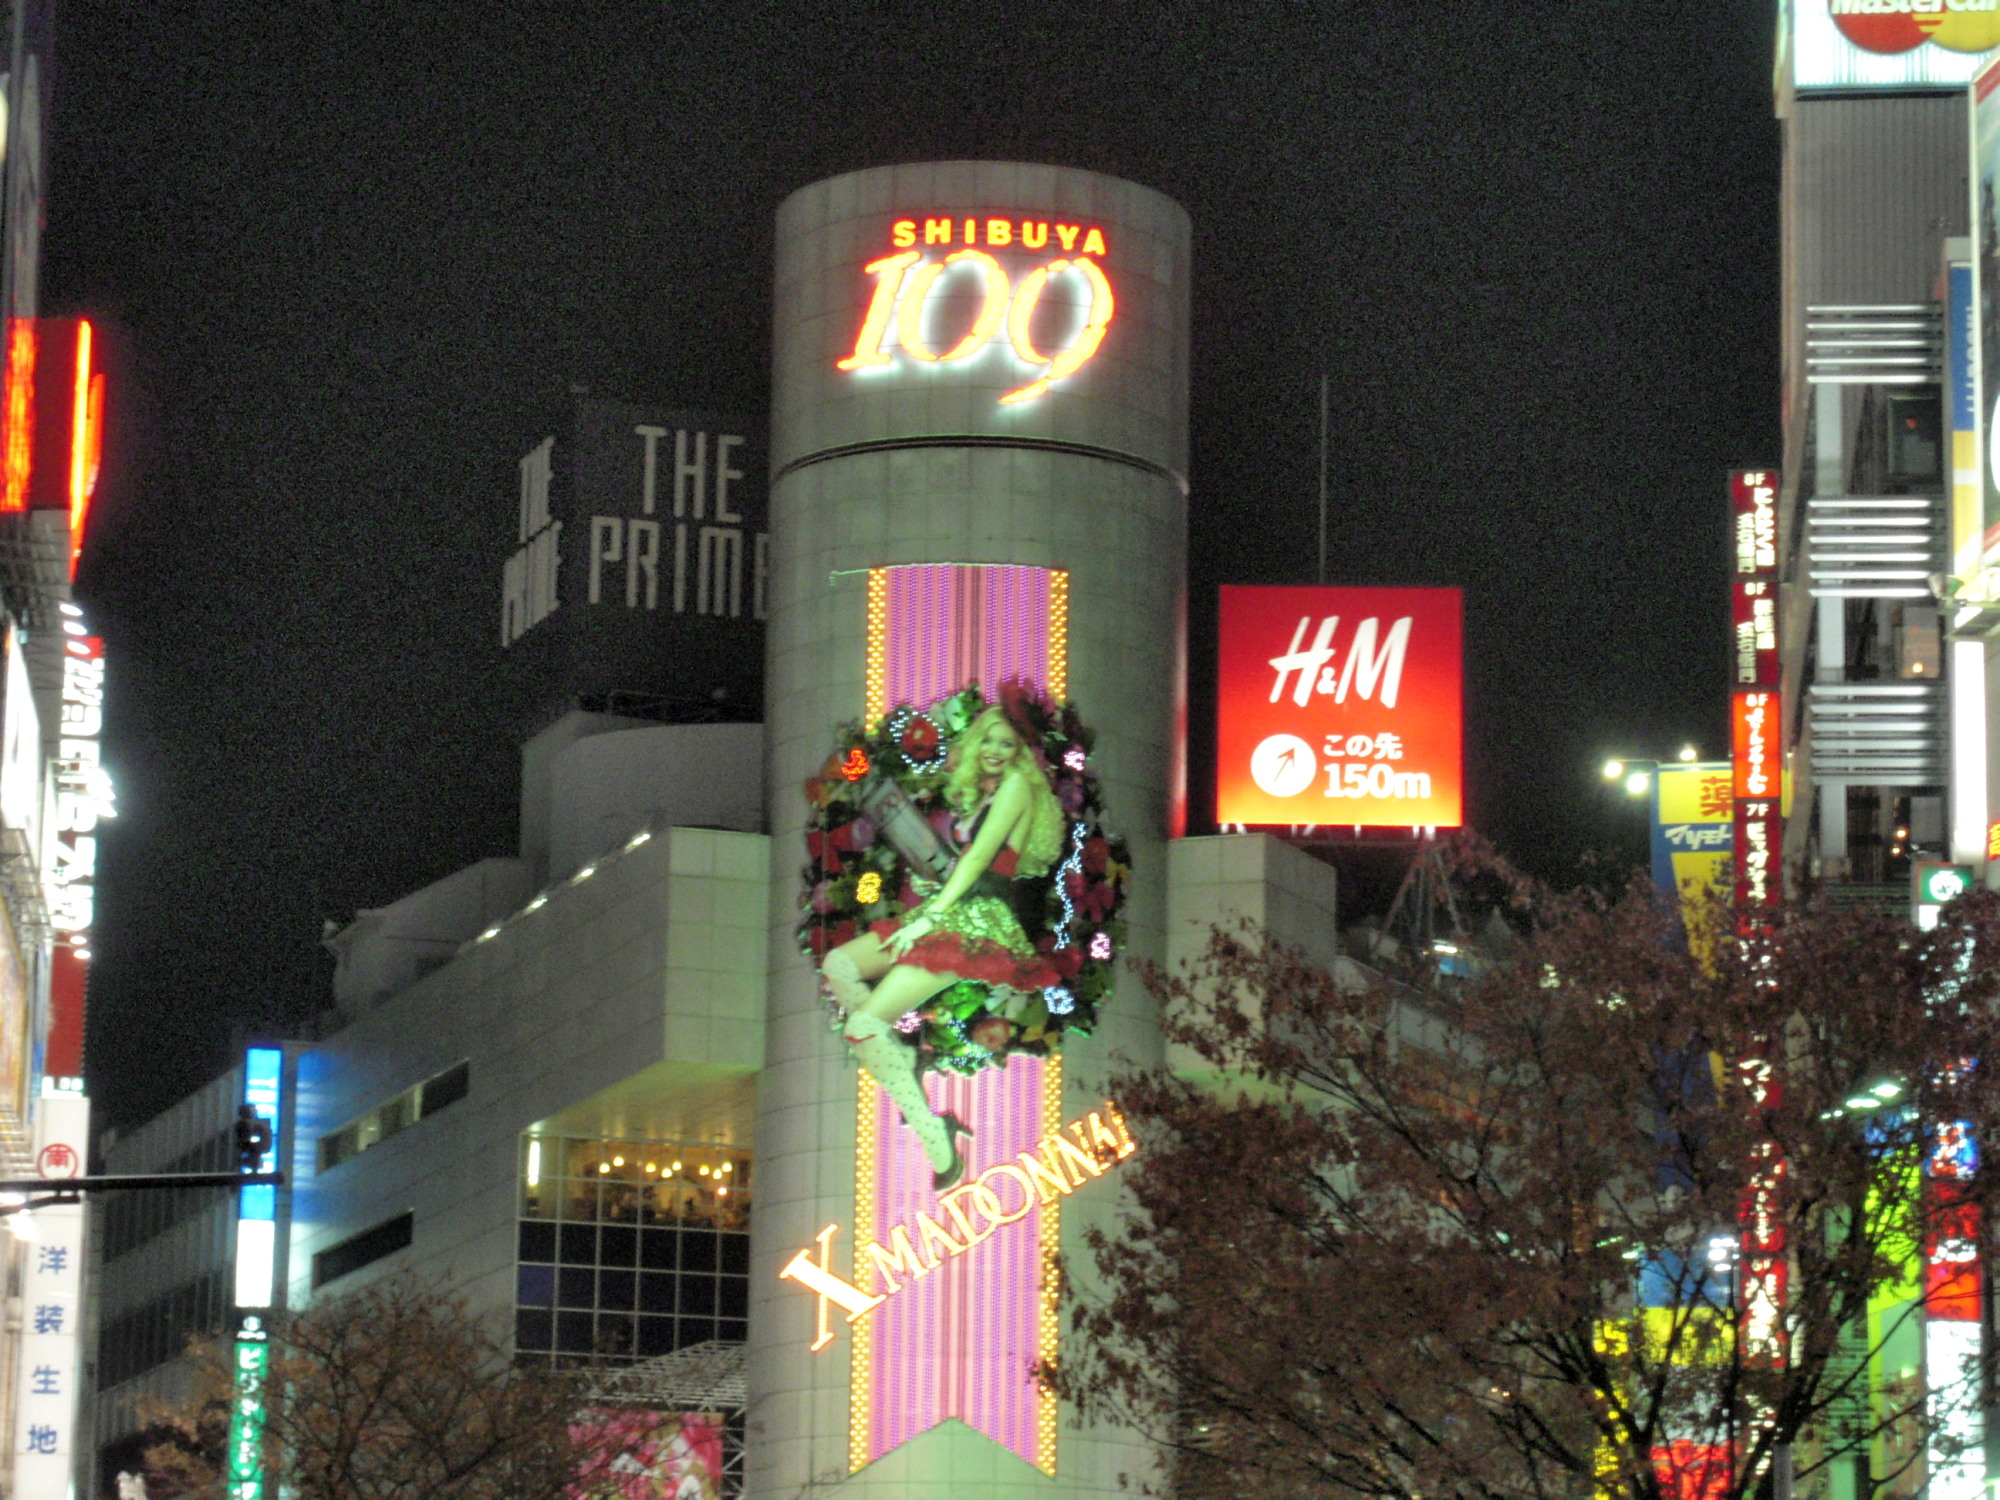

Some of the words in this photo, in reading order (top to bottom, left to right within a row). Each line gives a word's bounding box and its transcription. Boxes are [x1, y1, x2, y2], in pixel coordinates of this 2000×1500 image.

[892, 218, 1106, 256] SHIBUYA
[836, 248, 1116, 405] 109
[635, 424, 744, 523] THE
[1268, 615, 1413, 709] H&M
[1323, 732, 1404, 760] この先
[1323, 763, 1432, 799] 150m
[27, 1245, 68, 1455] 洋装生地
